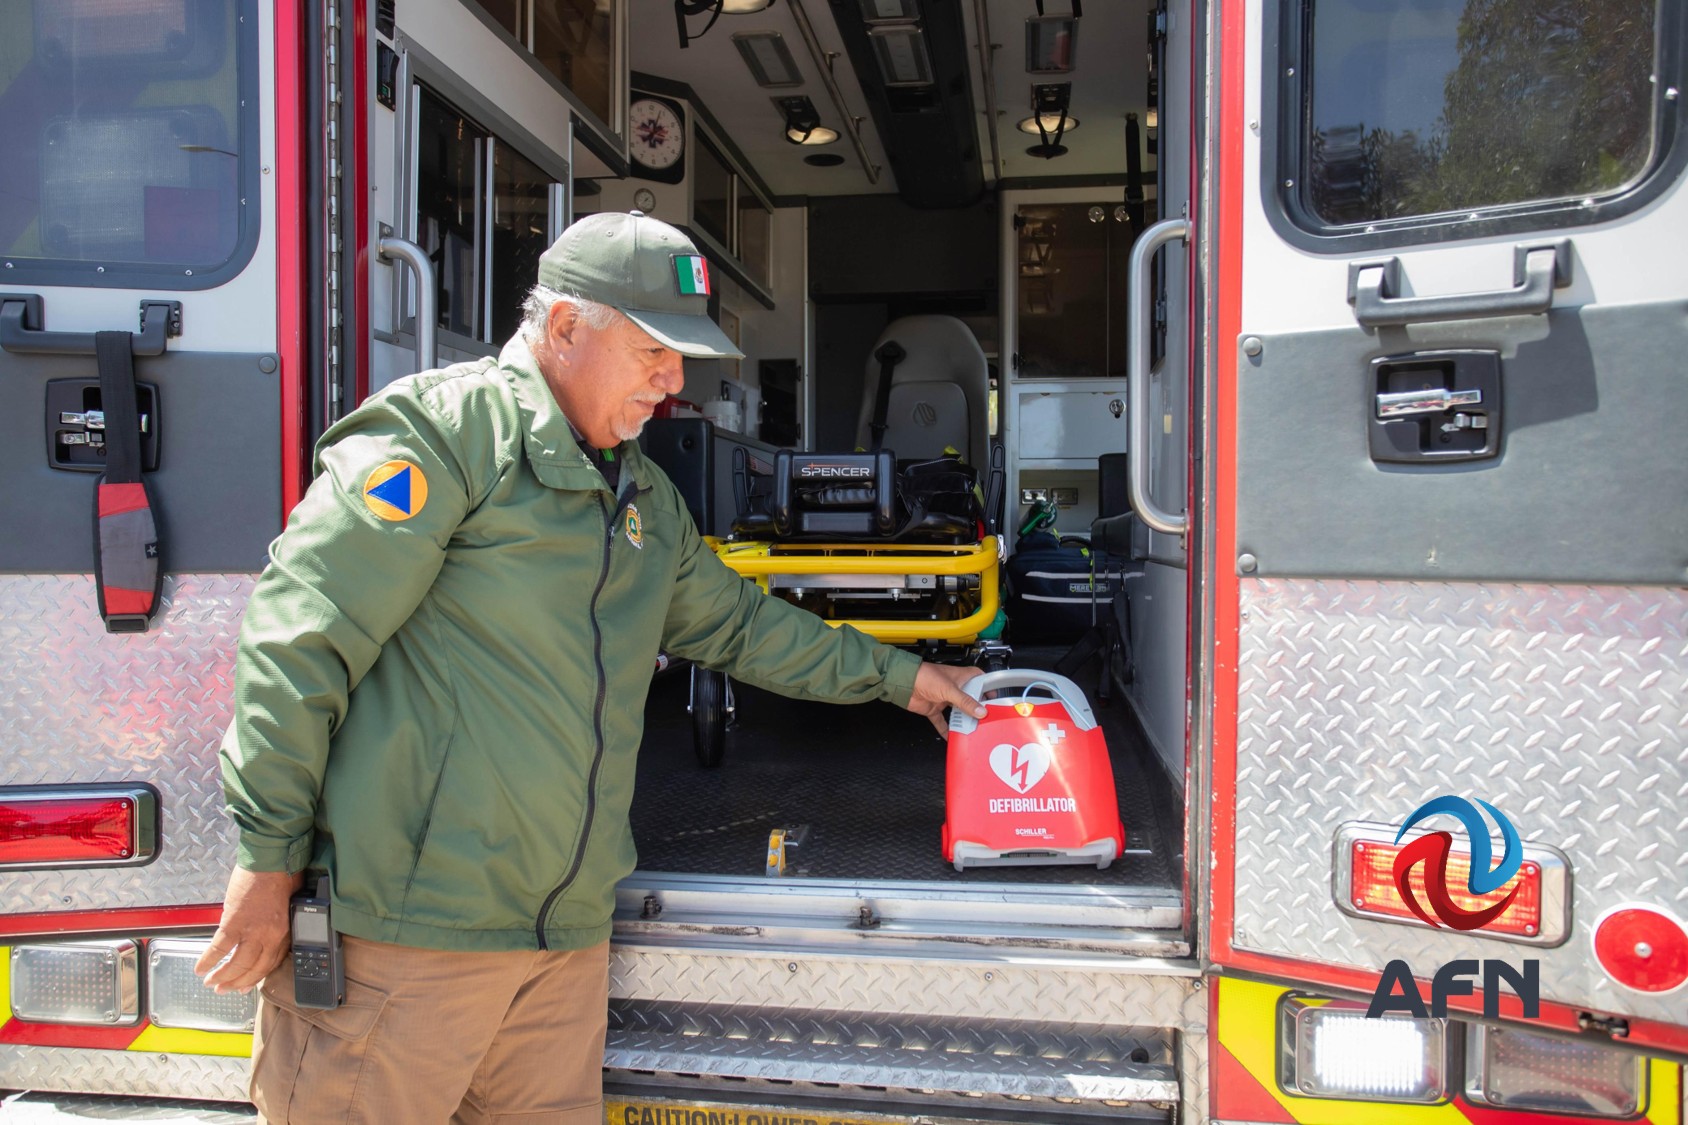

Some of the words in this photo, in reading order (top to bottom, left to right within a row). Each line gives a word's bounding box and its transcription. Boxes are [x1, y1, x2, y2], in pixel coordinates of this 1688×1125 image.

[801, 467, 870, 477] SPENCER
[989, 797, 1077, 814] DEFIBRILLATOR
[1015, 827, 1047, 836] SCHILLER
